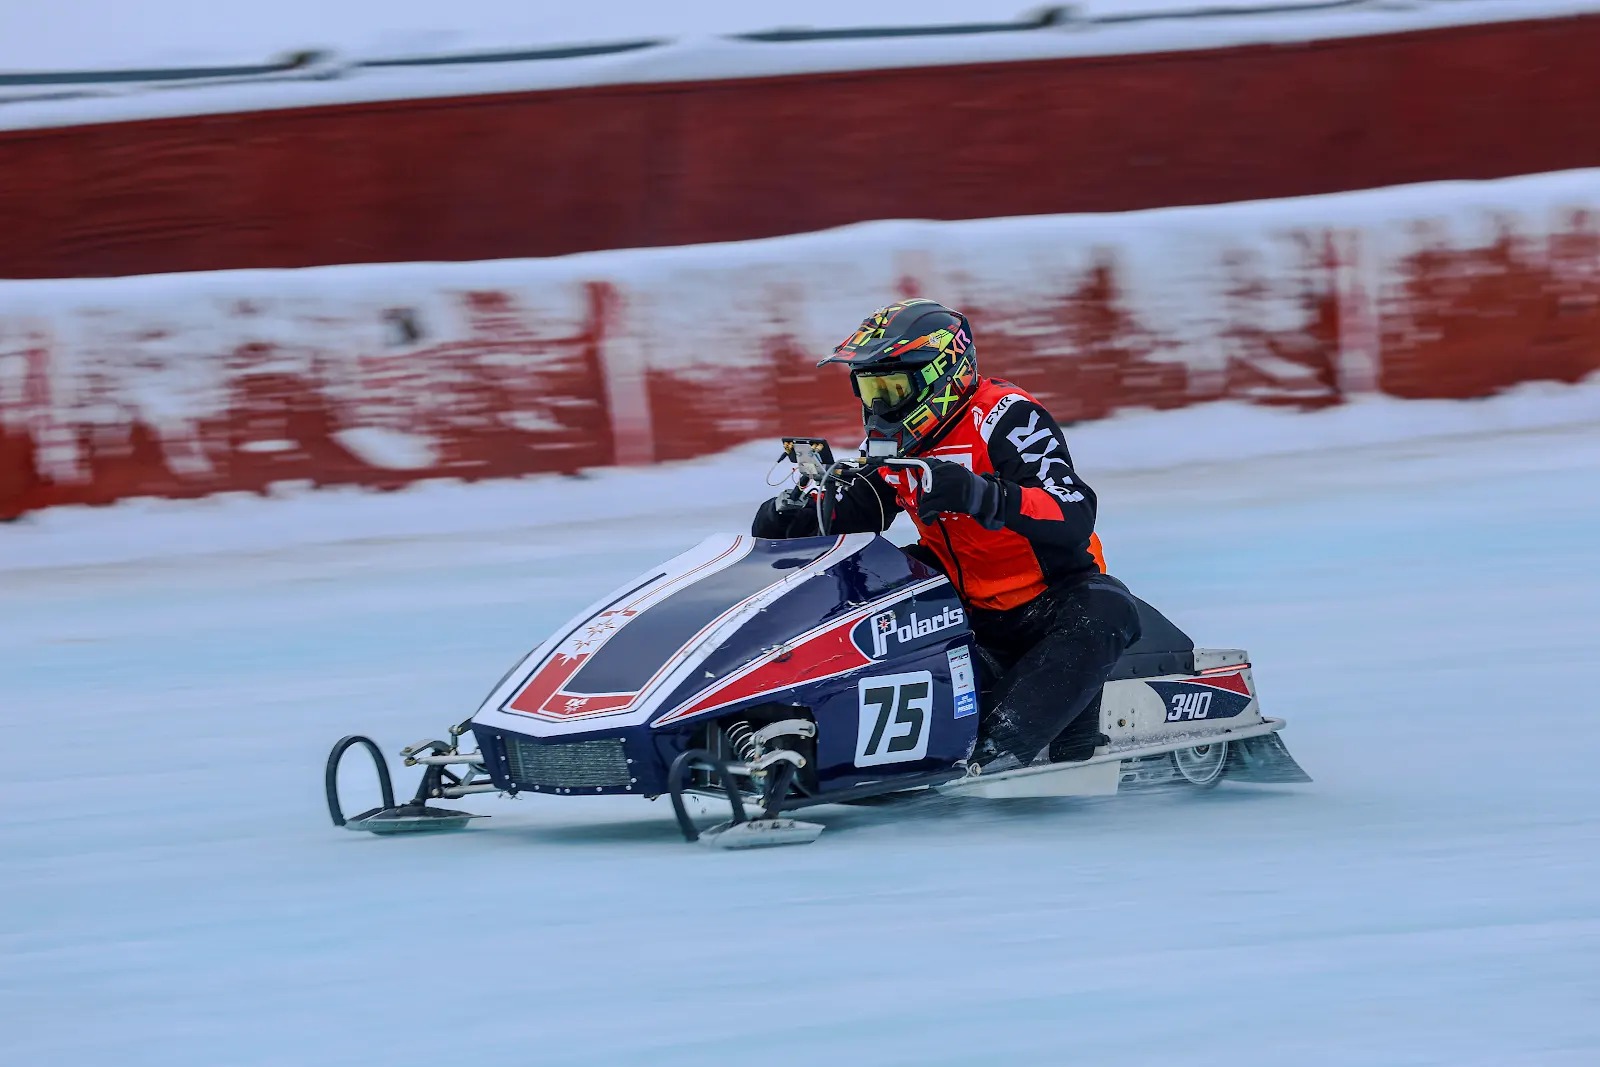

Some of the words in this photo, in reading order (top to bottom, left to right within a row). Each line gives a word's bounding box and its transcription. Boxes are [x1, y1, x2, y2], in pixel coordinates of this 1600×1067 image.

[933, 328, 972, 376] FXR
[985, 396, 1012, 425] FXR
[870, 606, 964, 659] Polaris
[863, 681, 929, 757] 75
[1167, 691, 1213, 721] 340
